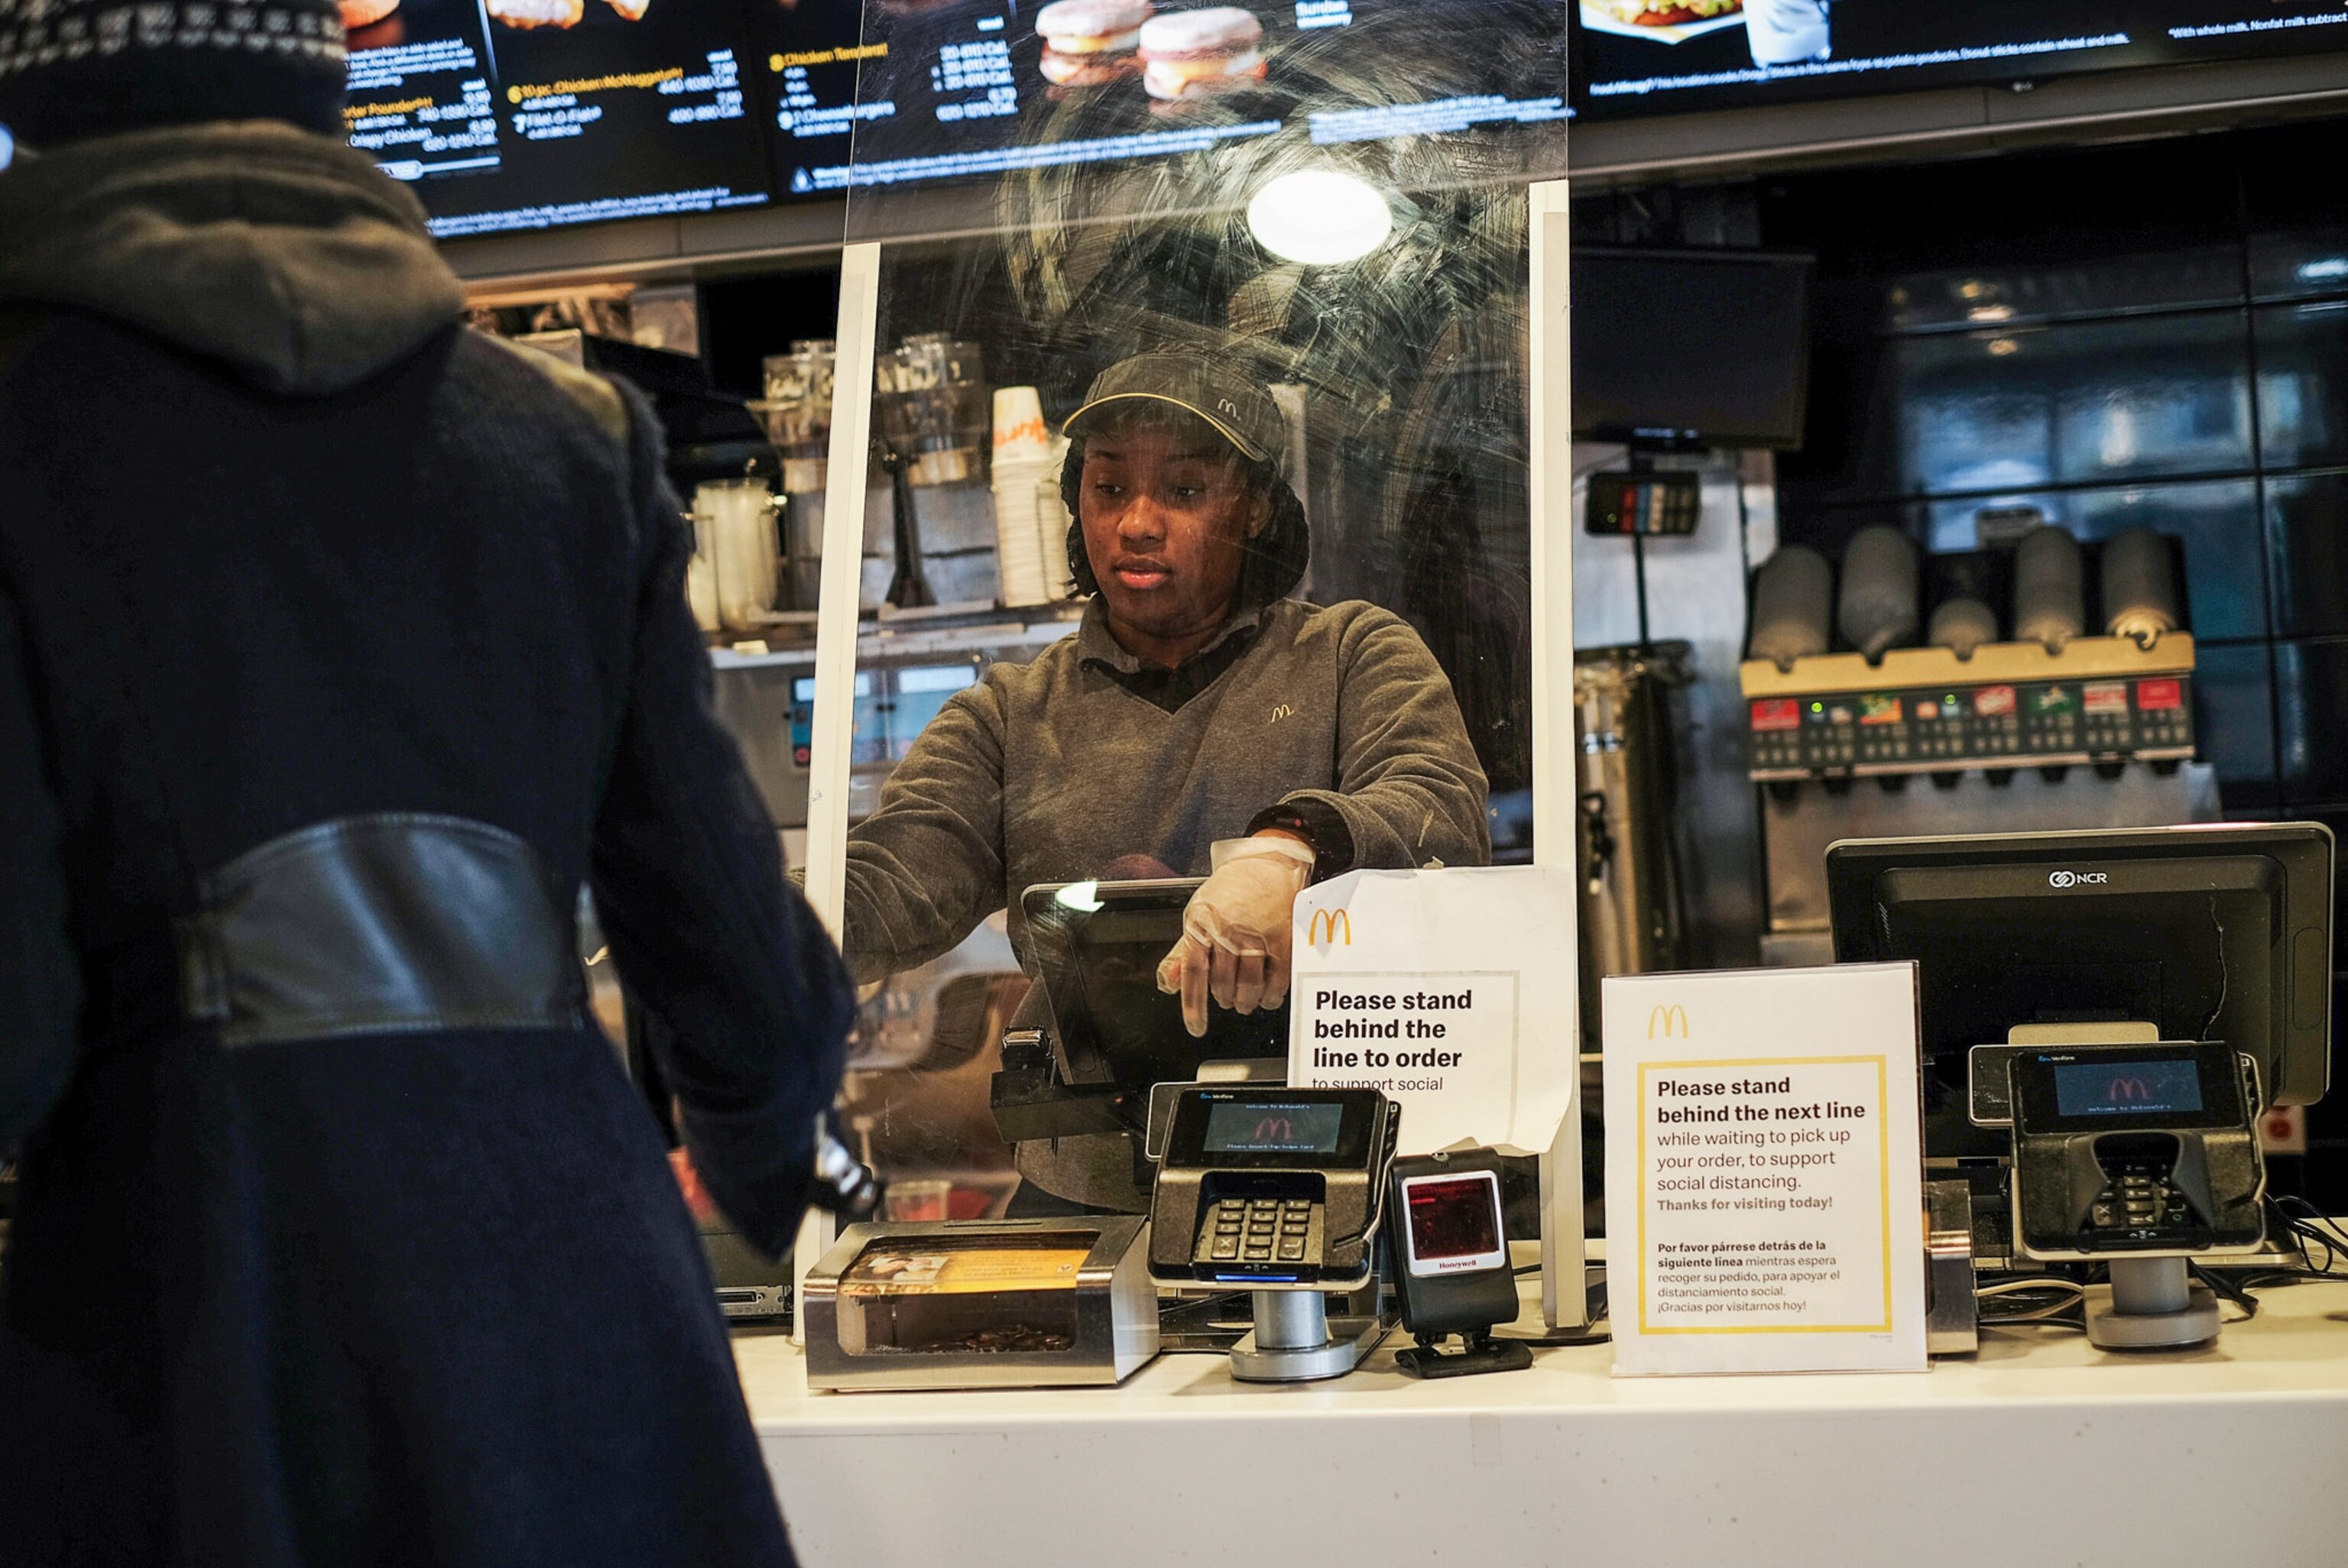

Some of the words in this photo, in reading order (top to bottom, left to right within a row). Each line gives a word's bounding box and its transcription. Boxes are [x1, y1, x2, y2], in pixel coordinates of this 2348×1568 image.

[2196, 24, 2226, 36] whole
[2250, 18, 2284, 31] Nonfat
[2285, 15, 2305, 27] milk
[2307, 12, 2347, 25] subtract
[2085, 34, 2104, 47] and
[2077, 873, 2107, 883] NCR
[1316, 990, 1396, 1010] Please
[1402, 990, 1472, 1010] stand
[1315, 1018, 1399, 1039] behind
[1406, 1019, 1446, 1039] the
[1314, 1047, 1358, 1067] line
[1364, 1048, 1390, 1067] to
[1395, 1048, 1463, 1068] order
[1312, 1077, 1328, 1089] to
[1332, 1078, 1394, 1090] support
[1397, 1077, 1444, 1091] social
[1658, 1080, 1726, 1097] Please
[1731, 1077, 1791, 1094] stand
[1658, 1106, 1729, 1123] behind
[1735, 1105, 1769, 1122] the
[1775, 1103, 1821, 1119] next
[1827, 1101, 1866, 1118] line
[1657, 1131, 1701, 1145] while
[1704, 1130, 1766, 1148] waiting
[1769, 1130, 1786, 1143] to
[1790, 1128, 1825, 1145] pick
[1829, 1130, 1850, 1145] up
[1657, 1156, 1694, 1172] your
[1698, 1153, 1745, 1168] order,
[1749, 1153, 1766, 1166] to
[1769, 1151, 1836, 1168] support
[1657, 1175, 1705, 1190] social
[1709, 1174, 1802, 1191] distancing.
[1657, 1198, 1707, 1211] Thanks
[1711, 1198, 1730, 1210] for
[1733, 1197, 1786, 1212] visiting
[1789, 1196, 1833, 1210] today!
[1658, 1243, 1677, 1253] Por
[1679, 1242, 1708, 1252] favor
[1711, 1241, 1756, 1255] párrese
[1758, 1240, 1796, 1252] detrás
[1798, 1240, 1813, 1251] de
[1815, 1240, 1826, 1251] la
[1439, 1259, 1477, 1269] Honeywell
[1658, 1256, 1712, 1270] siguiente
[1745, 1256, 1795, 1266] mientras
[1798, 1257, 1837, 1268] espera
[1658, 1273, 1701, 1285] recoger
[1704, 1274, 1717, 1282] su
[1719, 1272, 1761, 1285] pedido,
[1763, 1272, 1787, 1283] para
[1789, 1272, 1827, 1283] apoyar
[1830, 1270, 1840, 1280] el
[1658, 1287, 1749, 1297] distanciamiento
[1750, 1285, 1786, 1297] social.
[1658, 1301, 1704, 1314] ¡Gracias
[1705, 1302, 1723, 1314] por
[1726, 1301, 1781, 1311] visitarnos
[1782, 1300, 1807, 1313] hoy!
